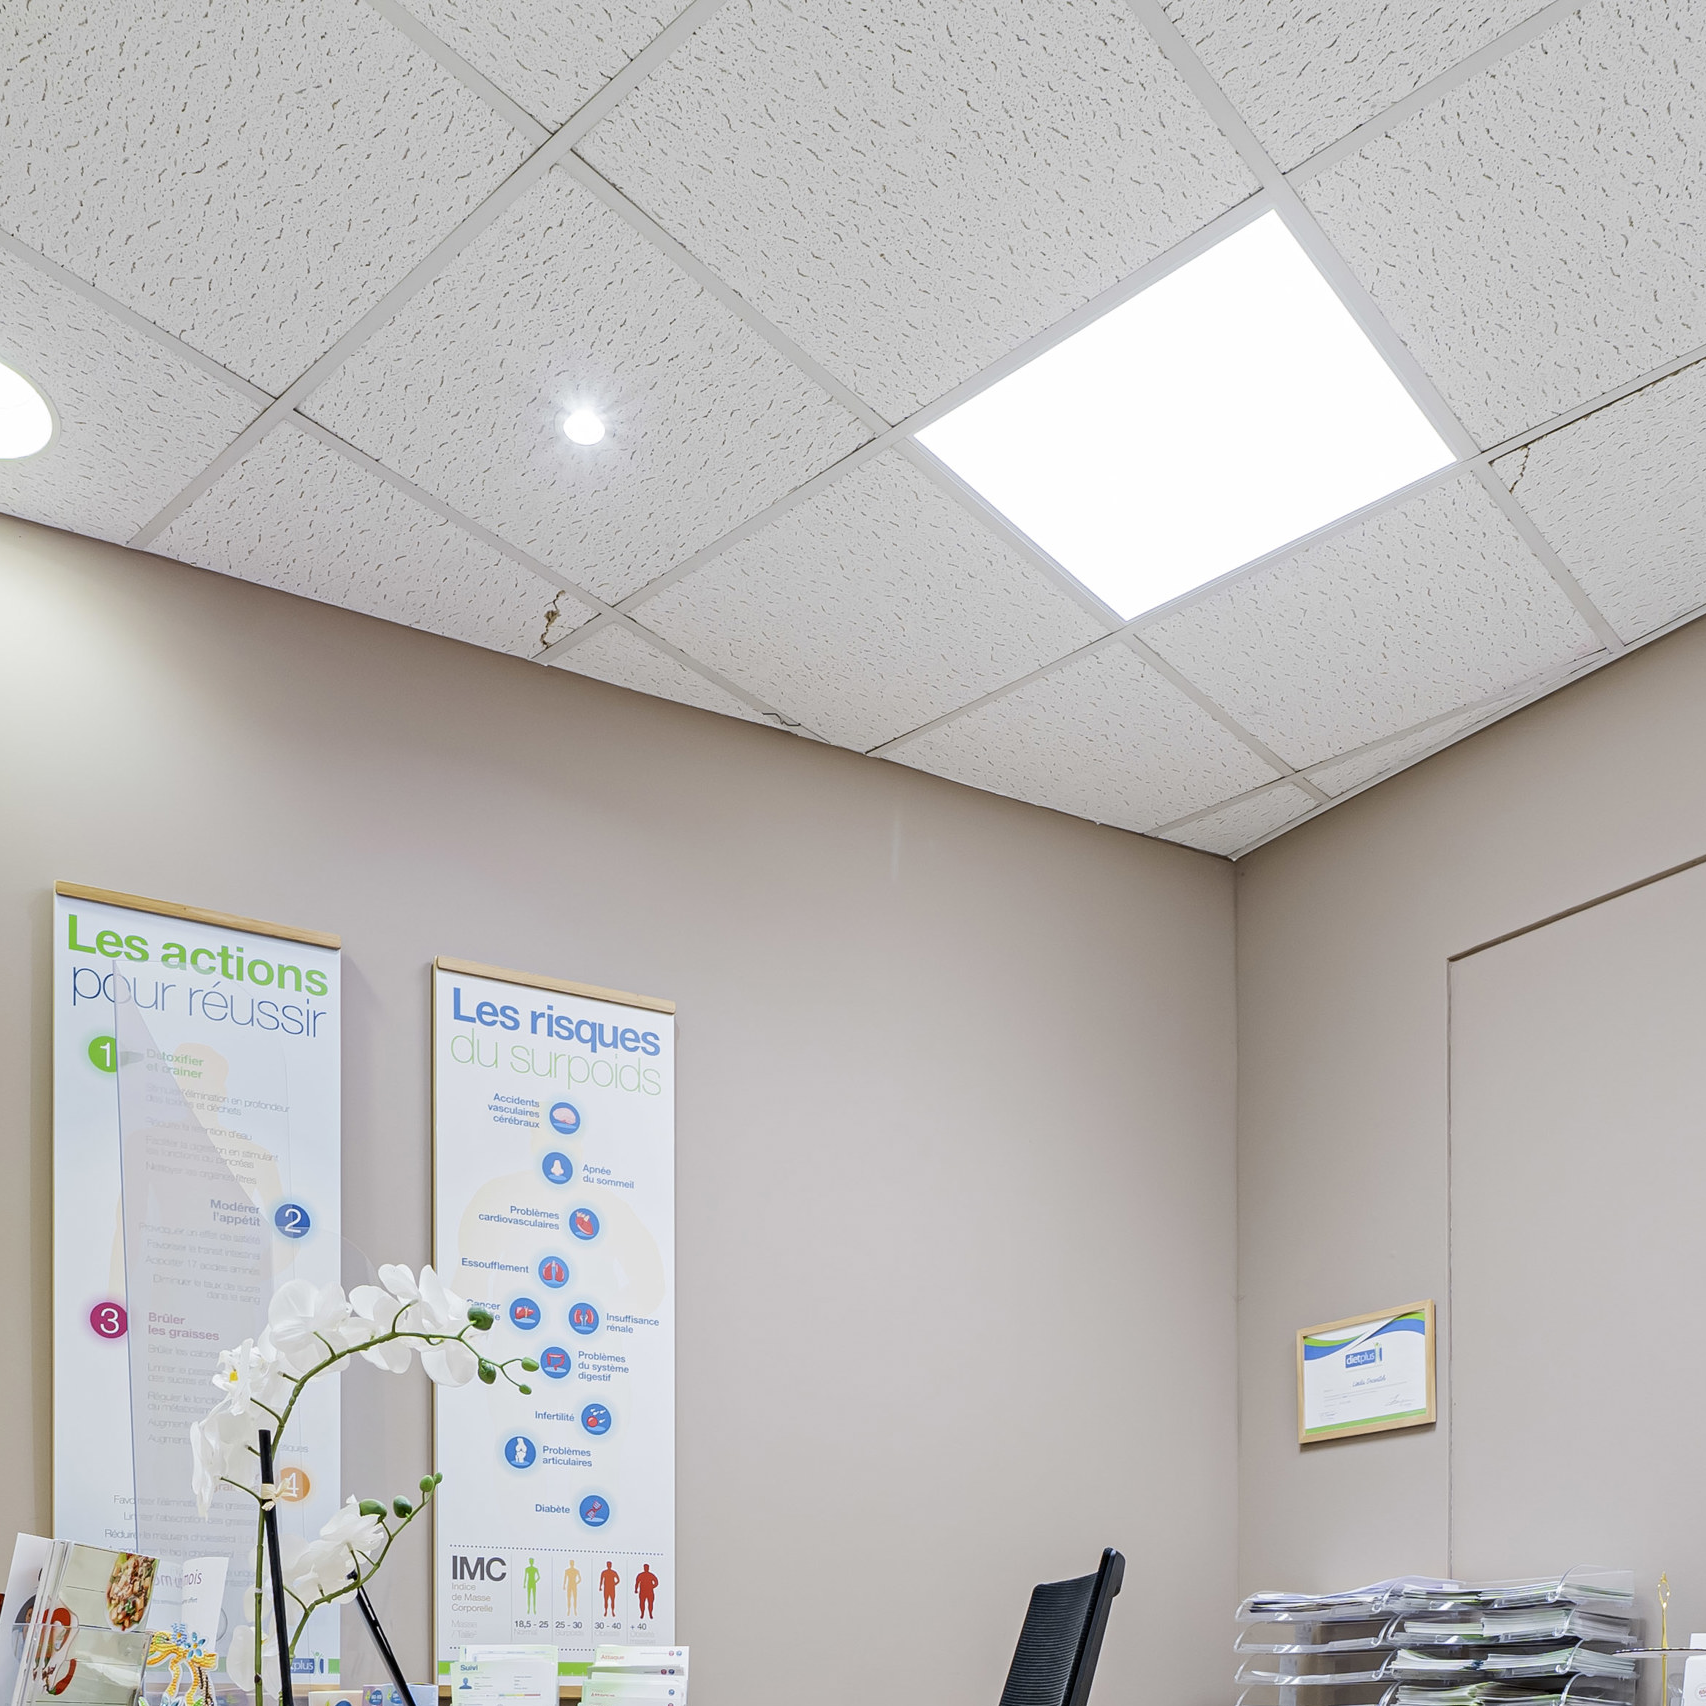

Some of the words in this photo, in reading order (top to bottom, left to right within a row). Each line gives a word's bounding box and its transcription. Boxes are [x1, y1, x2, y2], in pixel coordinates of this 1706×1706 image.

[68, 914, 150, 963] Les
[161, 942, 329, 997] actions
[73, 967, 176, 1011] pour
[189, 981, 327, 1037] réussir
[453, 987, 520, 1031] Les
[530, 1004, 661, 1056] risques
[99, 1042, 110, 1067] 1
[450, 1028, 498, 1069] du
[510, 1045, 661, 1096] surpoids
[493, 1093, 540, 1108] Accidents
[487, 1103, 540, 1118] vasculaires
[493, 1114, 540, 1129] cérébraux
[583, 1164, 611, 1176] Apnée
[583, 1175, 594, 1184] du
[596, 1178, 634, 1189] sommeil
[210, 1199, 260, 1214] Modérer
[510, 1206, 560, 1220] Problèmes
[213, 1211, 261, 1227] l'appétit
[284, 1208, 302, 1234] 2
[478, 1213, 560, 1230] cardiovasculaires
[461, 1257, 529, 1274] Essoufflement
[100, 1308, 120, 1334] 3
[148, 1311, 186, 1325] Brûler
[606, 1312, 660, 1326] Insuffisance
[148, 1325, 166, 1336] les
[168, 1327, 220, 1341] graisses
[606, 1323, 634, 1334] rénale
[578, 1351, 626, 1363] Problèmes
[1347, 1351, 1375, 1365] dietplus
[578, 1361, 590, 1371] du
[592, 1363, 629, 1375] système
[578, 1372, 611, 1383] digestif
[535, 1411, 575, 1422] Infertilité
[543, 1445, 591, 1457] Problèmes
[543, 1457, 593, 1467] articulaires
[535, 1504, 571, 1514] Diabète
[452, 1555, 507, 1582] IMC
[451, 1583, 476, 1591] Indice
[452, 1593, 462, 1601] de
[464, 1593, 491, 1602] Masse
[451, 1604, 493, 1613] Corporelle
[515, 1620, 531, 1629] 18,5
[539, 1621, 549, 1629] 25
[555, 1621, 565, 1629] 25
[573, 1621, 583, 1629] 30
[594, 1622, 604, 1630] 30
[612, 1622, 622, 1630] 40
